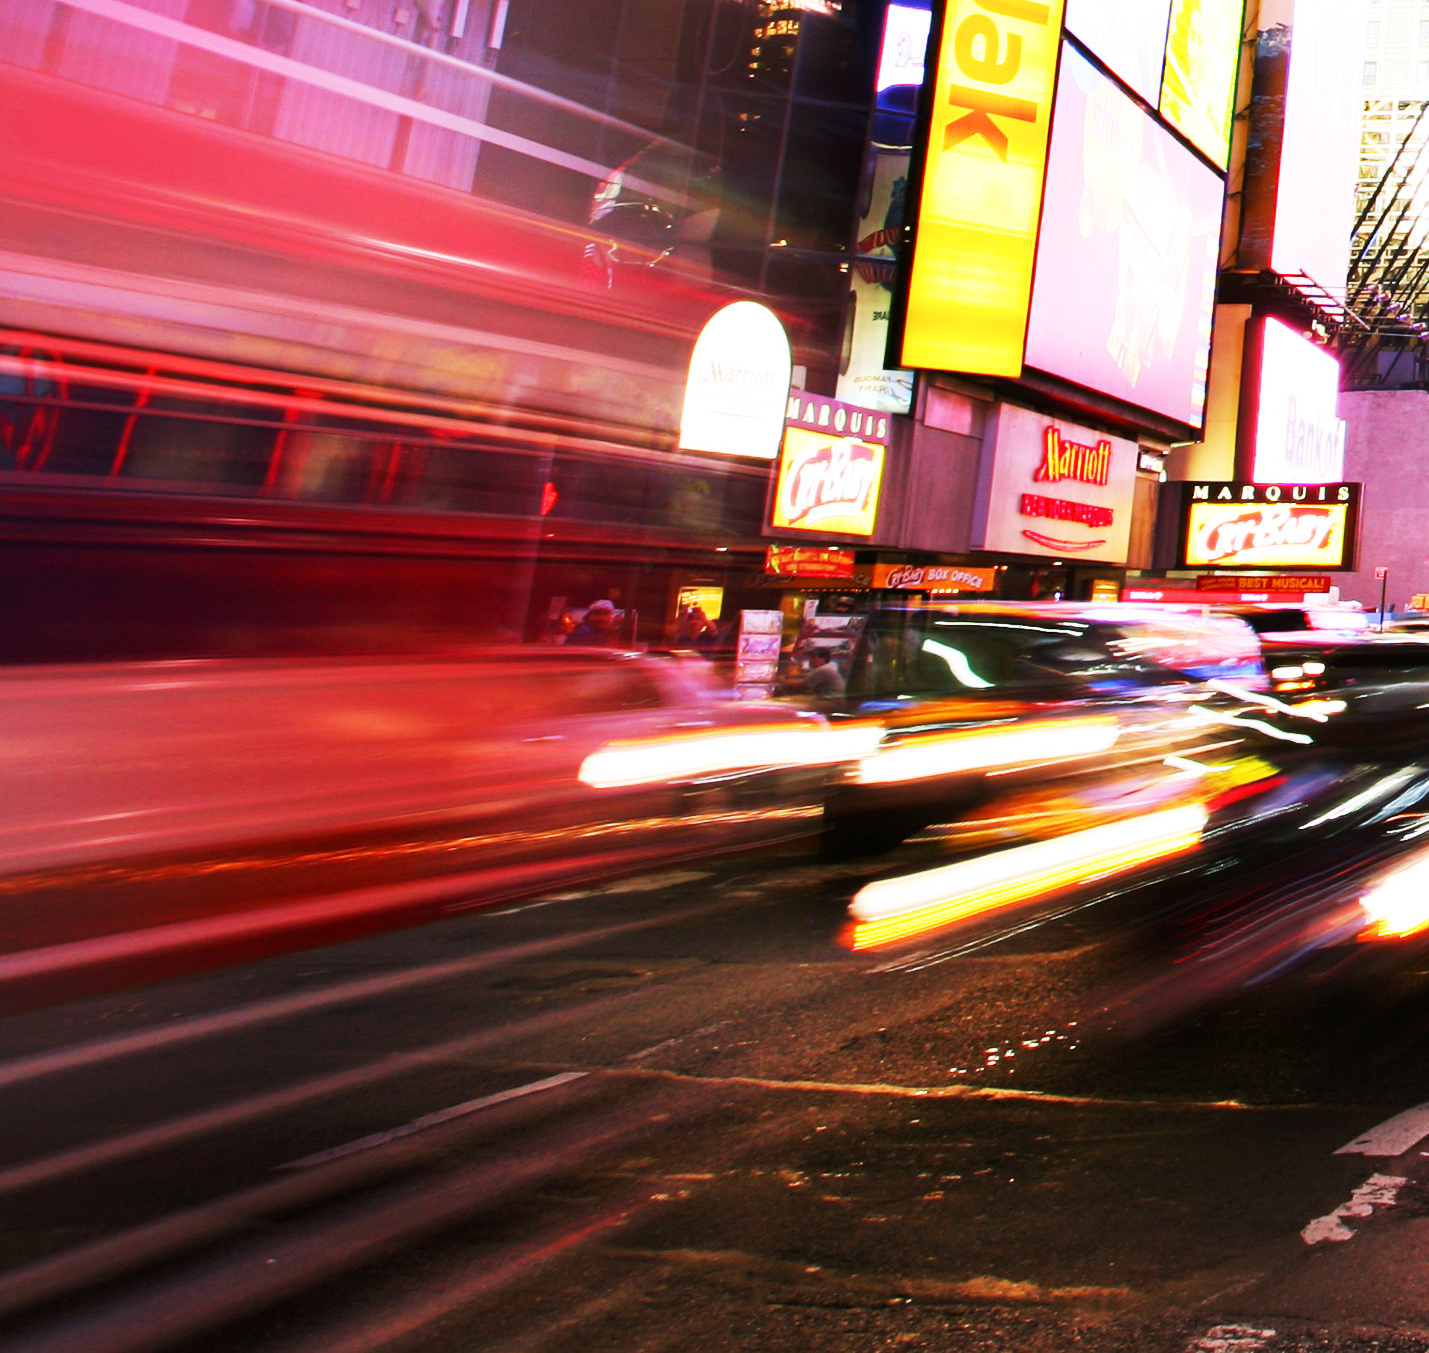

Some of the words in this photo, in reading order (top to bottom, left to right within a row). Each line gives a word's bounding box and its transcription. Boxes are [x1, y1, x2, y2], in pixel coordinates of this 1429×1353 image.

[786, 397, 887, 439] MARQUIS
[1034, 425, 1112, 486] Marriott
[1192, 485, 1350, 501] MARQUIS
[928, 567, 948, 581] BOX
[951, 570, 983, 588] OFFICE
[1238, 577, 1268, 590] BEST
[1271, 577, 1325, 590] MUSICAL!
